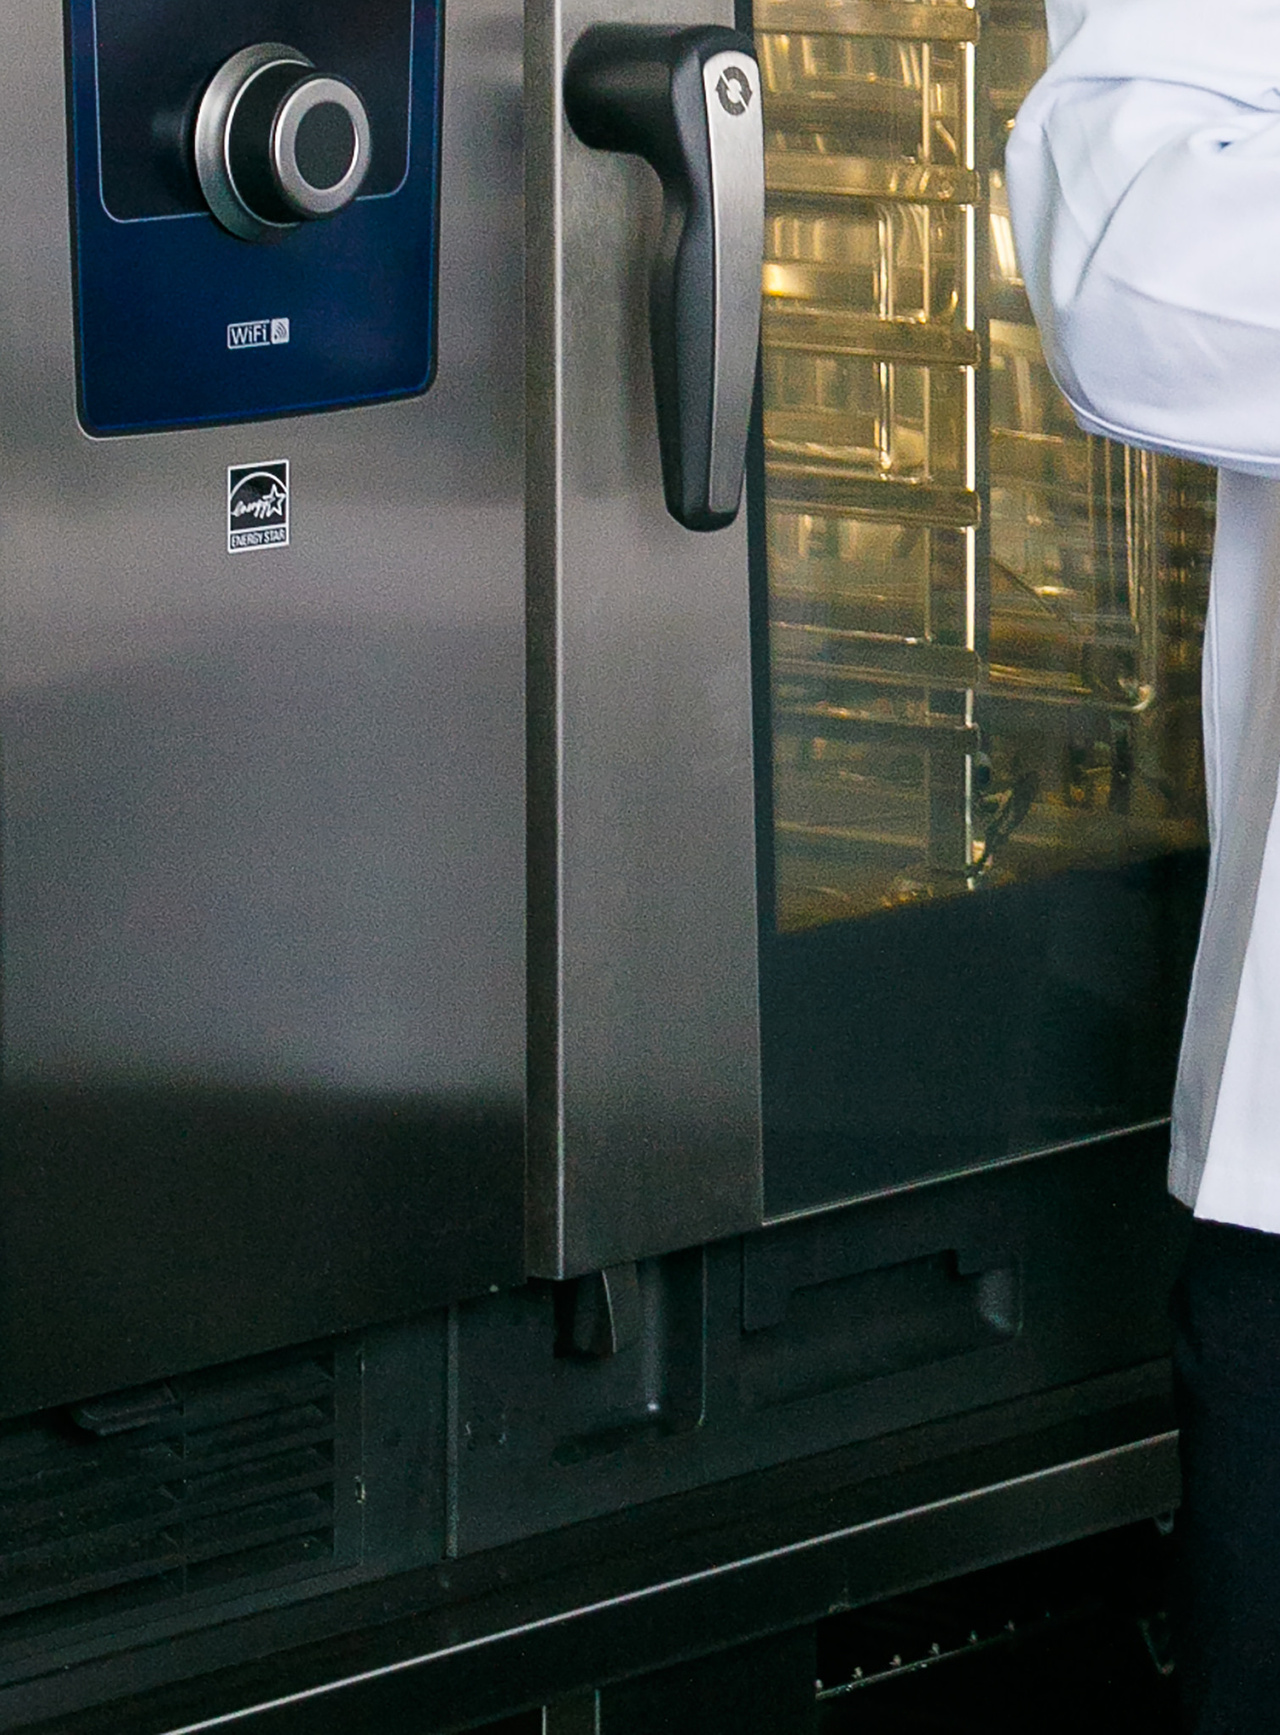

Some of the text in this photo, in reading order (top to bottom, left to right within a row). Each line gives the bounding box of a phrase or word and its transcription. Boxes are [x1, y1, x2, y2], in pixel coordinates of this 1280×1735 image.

[230, 324, 267, 345] WiFi
[231, 528, 286, 548] ENERGY STAR
